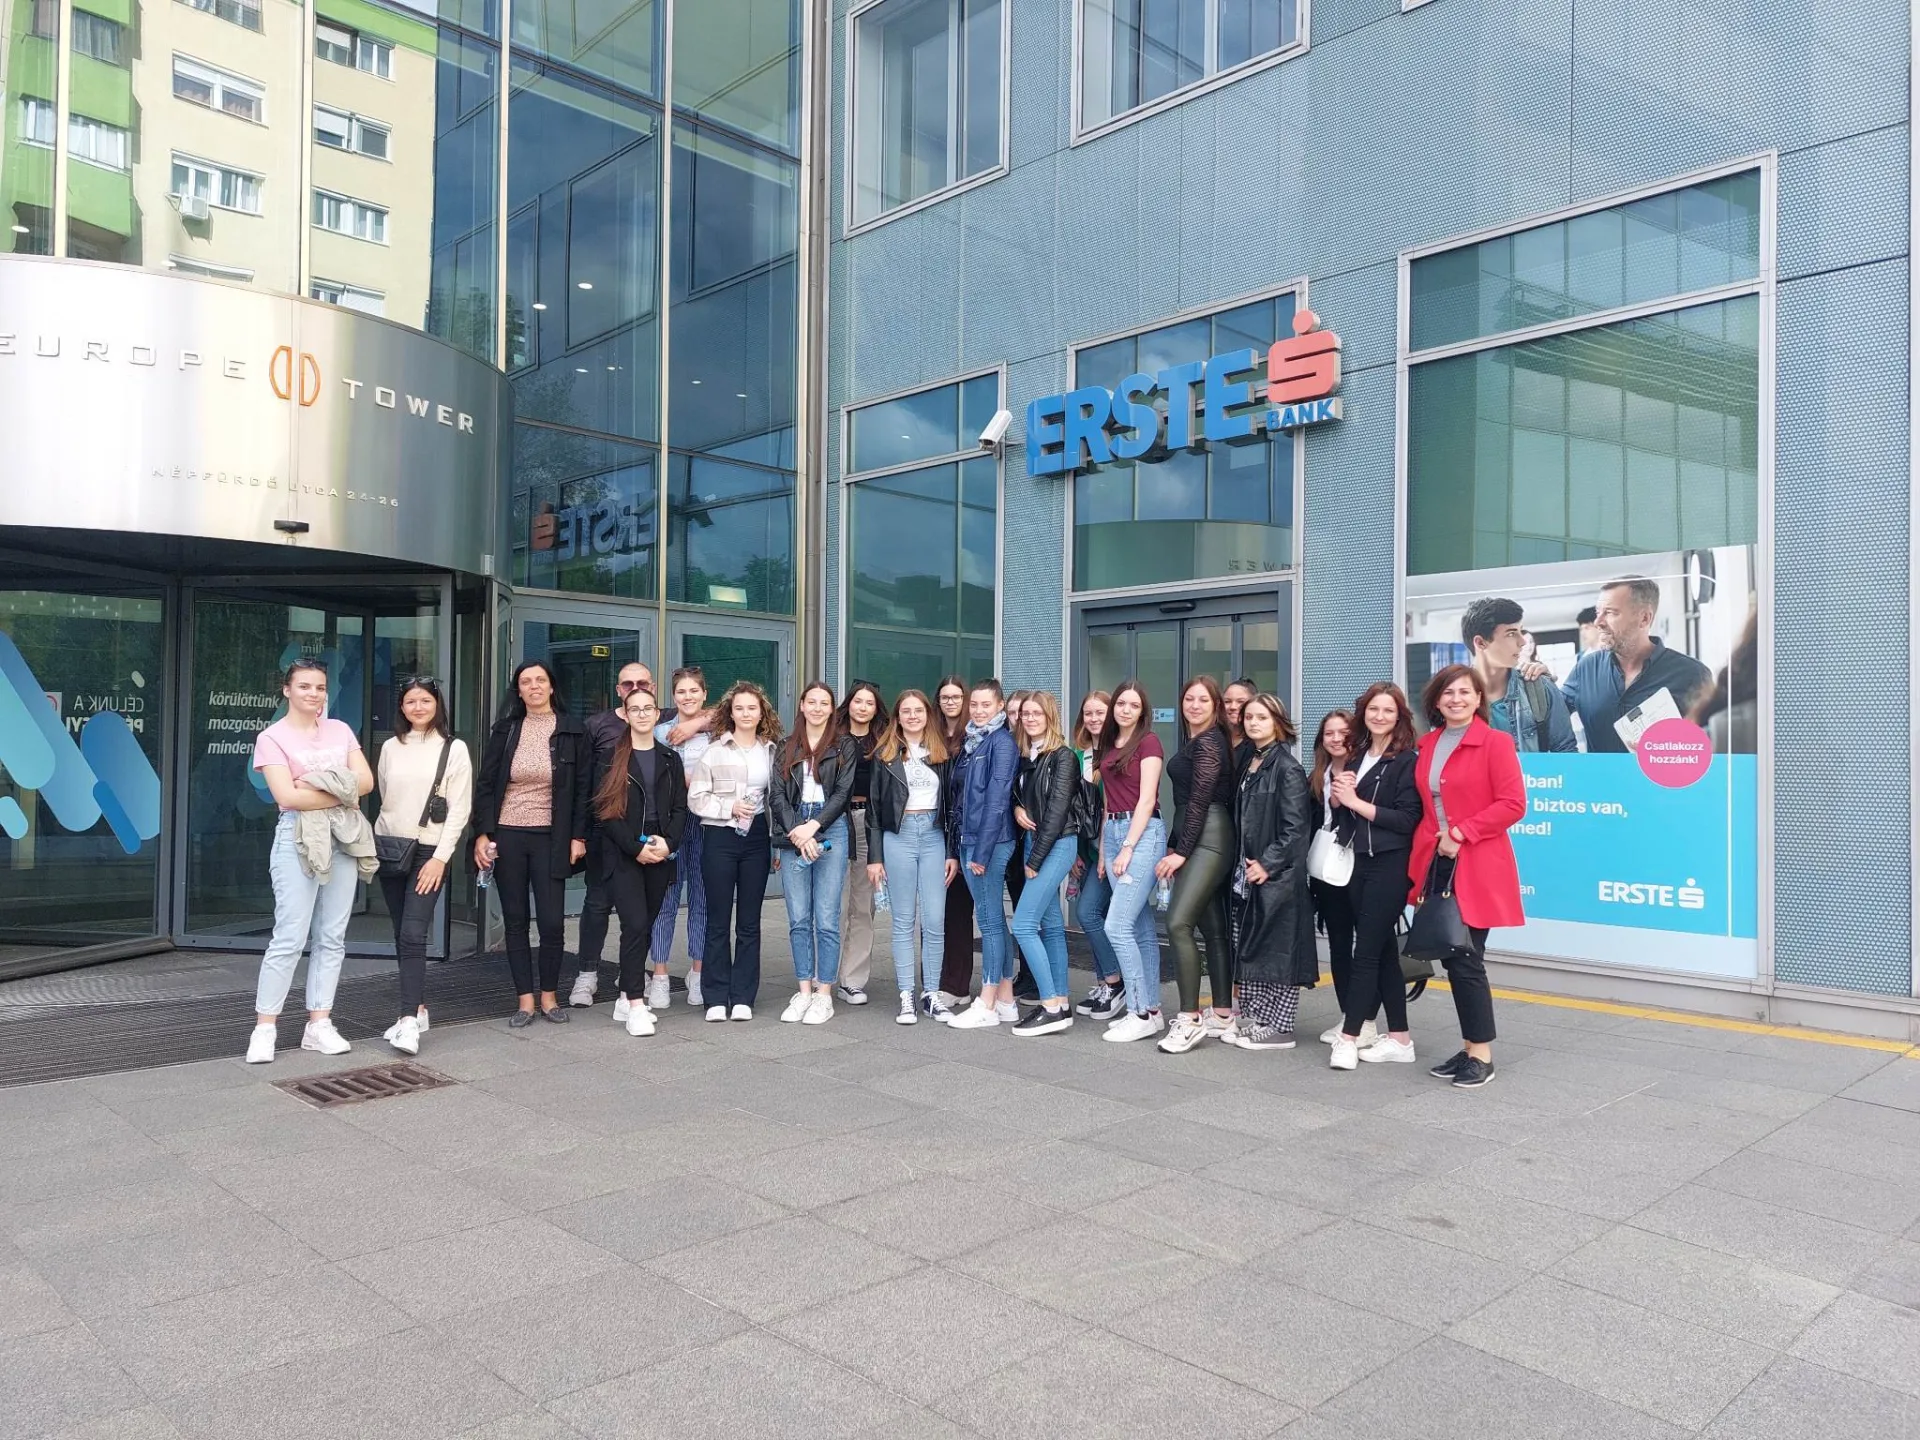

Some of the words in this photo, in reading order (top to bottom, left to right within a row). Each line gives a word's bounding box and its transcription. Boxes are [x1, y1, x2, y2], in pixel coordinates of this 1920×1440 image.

[0, 333, 247, 380] EUROPE
[341, 377, 474, 434] TOWER
[1027, 348, 1258, 477] ERSTE
[1266, 397, 1334, 431] BANK
[346, 489, 400, 508] 24-26
[209, 691, 280, 708] körülöttünk
[208, 717, 277, 733] mozgásba
[207, 740, 254, 754] minden
[1644, 741, 1704, 751] Csatlakozz
[1649, 754, 1699, 764] hozzánk!
[1533, 797, 1586, 813] biztos
[1591, 801, 1628, 818] van,
[1598, 880, 1675, 906] ERSTE
